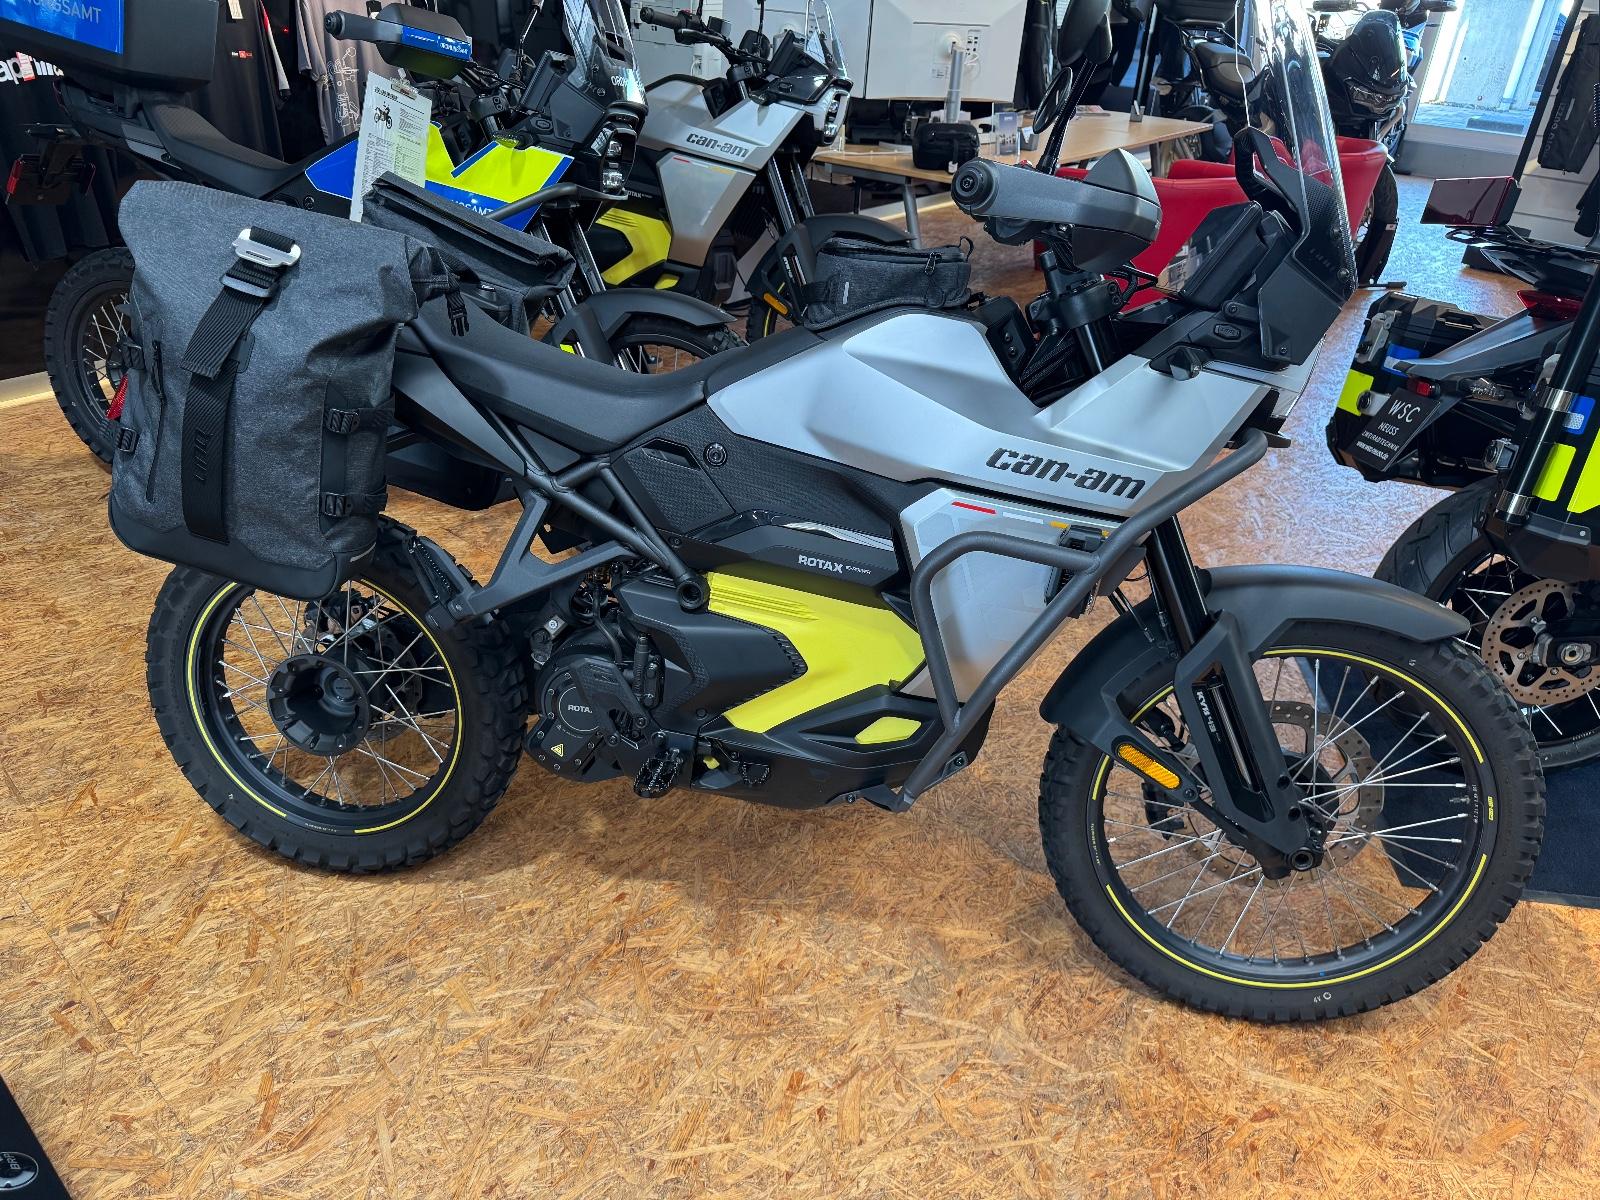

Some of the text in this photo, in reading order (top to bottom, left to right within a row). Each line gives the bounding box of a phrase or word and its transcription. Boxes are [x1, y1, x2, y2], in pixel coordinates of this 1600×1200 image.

[686, 133, 750, 158] can-am
[1387, 399, 1421, 423] WSC
[1377, 421, 1400, 436] NEUSS
[985, 447, 1146, 500] can-am
[798, 554, 844, 574] ROTAX
[567, 704, 593, 714] ROTA
[3, 1153, 21, 1170] BRP
